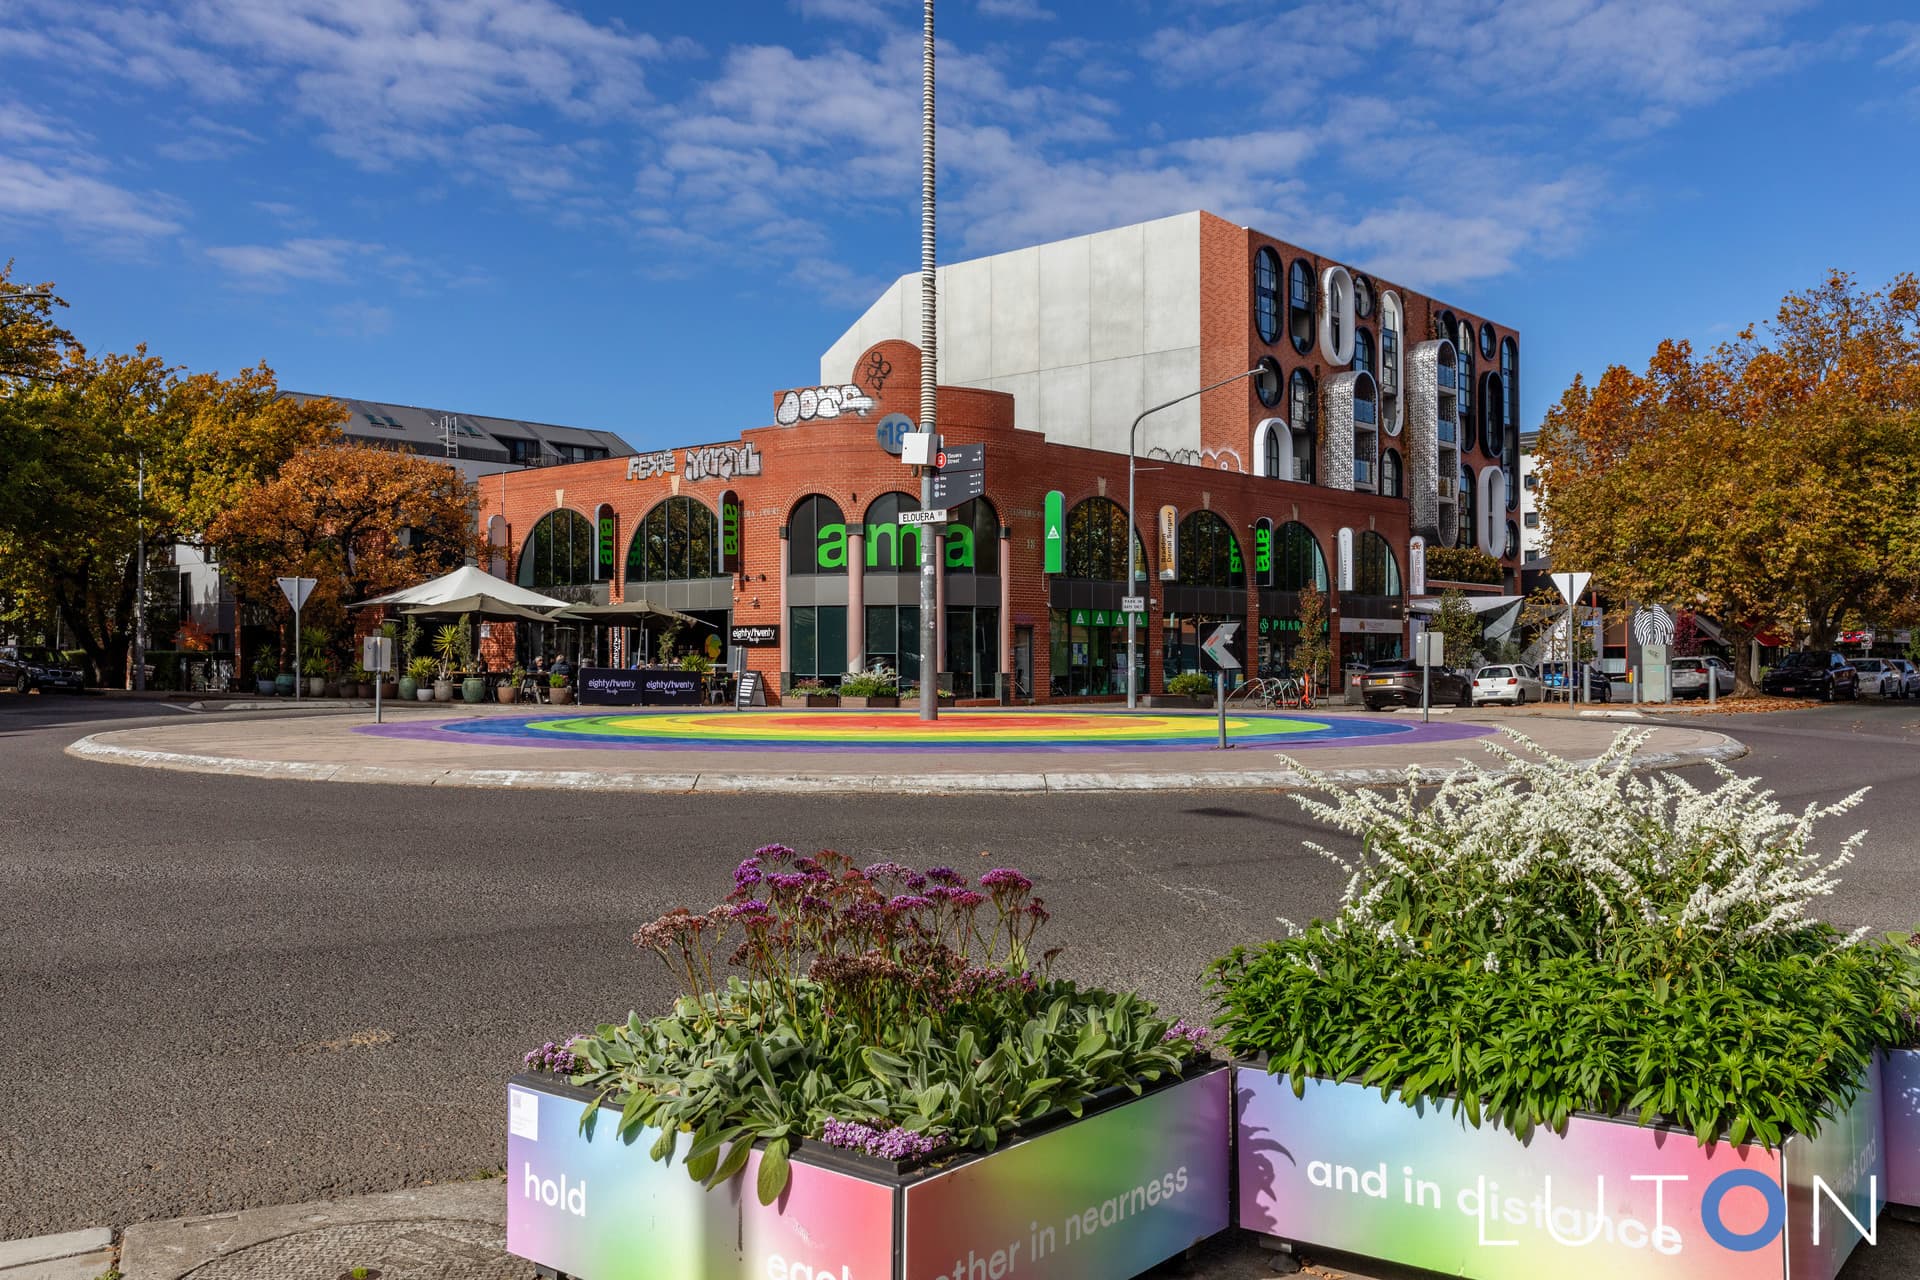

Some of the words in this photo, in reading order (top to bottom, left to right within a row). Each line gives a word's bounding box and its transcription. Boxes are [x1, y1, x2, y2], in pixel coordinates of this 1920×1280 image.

[723, 503, 739, 555] ama
[902, 511, 935, 522] ELOUERA
[599, 518, 614, 565] ama
[1255, 528, 1270, 572] ama
[732, 627, 775, 639] eighty/twenty
[588, 678, 636, 689] eighty/twenty
[646, 679, 695, 690] eighty/twenty
[524, 1161, 586, 1217] hold
[1307, 1160, 1388, 1199] and
[1402, 1166, 1441, 1209] in
[1457, 1178, 1683, 1256] distance
[1031, 1220, 1056, 1262] in
[1066, 1166, 1189, 1246] nearness
